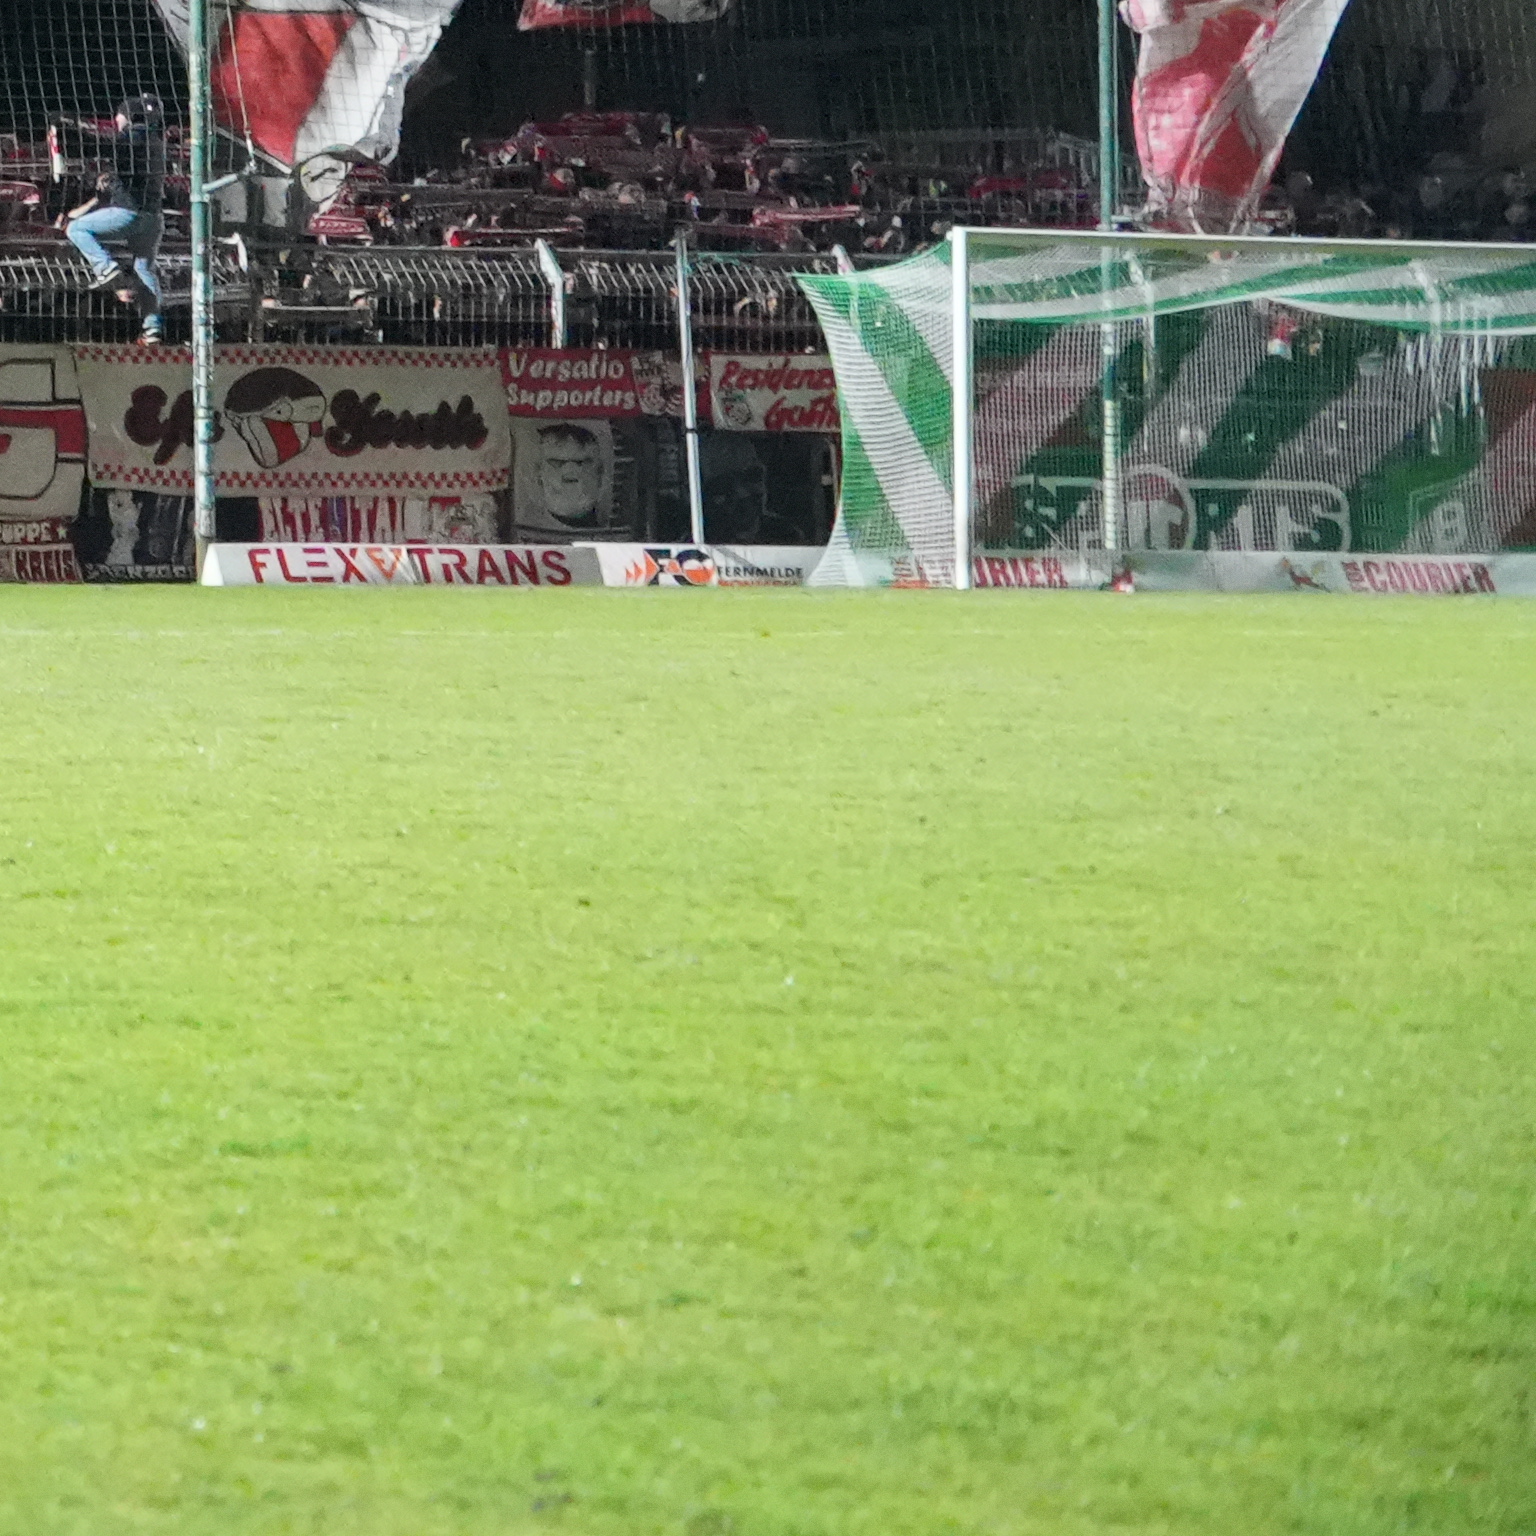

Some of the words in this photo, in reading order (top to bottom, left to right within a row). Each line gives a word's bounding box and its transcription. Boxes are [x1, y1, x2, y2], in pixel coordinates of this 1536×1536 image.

[507, 383, 638, 412] Supporters
[247, 548, 370, 585] FLEX
[407, 548, 573, 586] TRANS
[1363, 561, 1497, 594] COURIER
